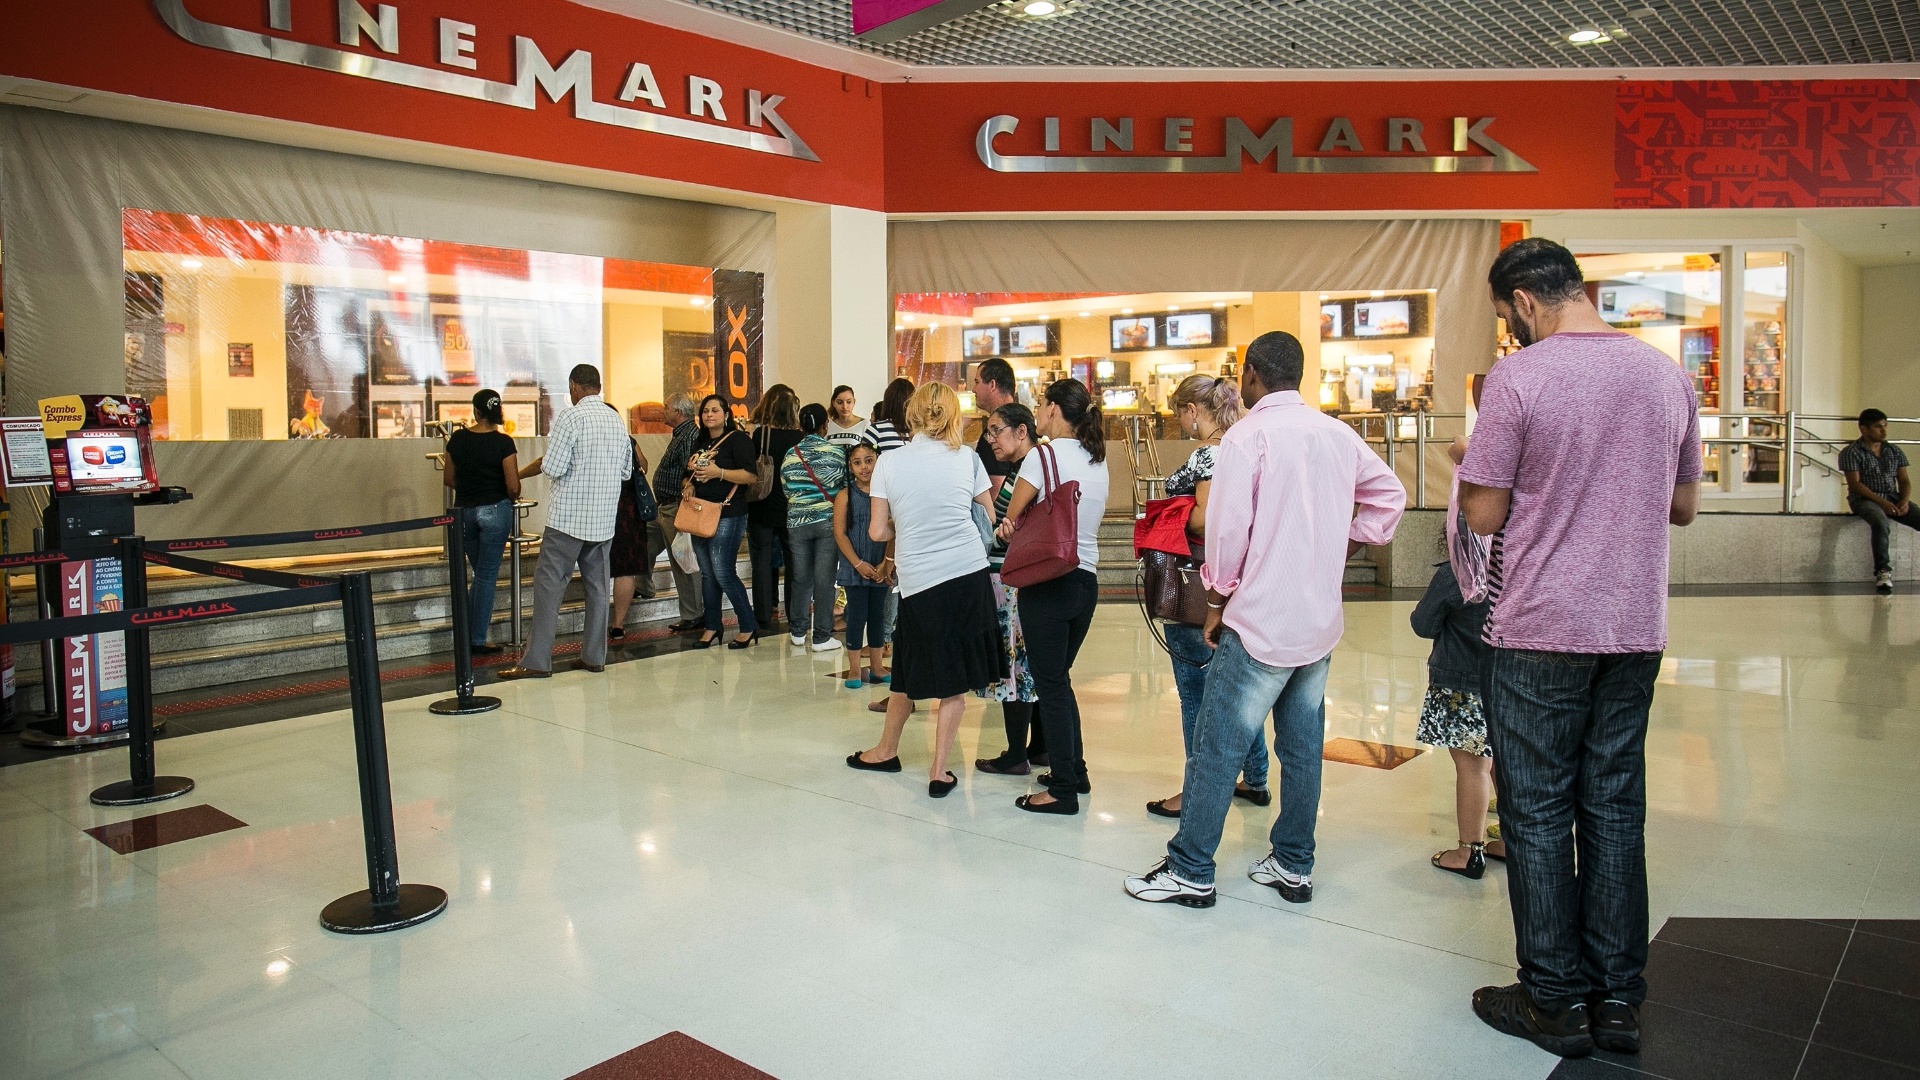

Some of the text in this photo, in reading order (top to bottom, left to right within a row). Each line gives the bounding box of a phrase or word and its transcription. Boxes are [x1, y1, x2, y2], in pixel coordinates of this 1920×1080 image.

[976, 115, 1538, 173] CINEMARK
[44, 405, 76, 414] Combo
[46, 413, 82, 423] Express
[314, 529, 363, 539] CINEMARK
[168, 540, 229, 550] CINEMARK
[131, 602, 237, 624] CINEMARK
[68, 561, 91, 733] CINEMRK
